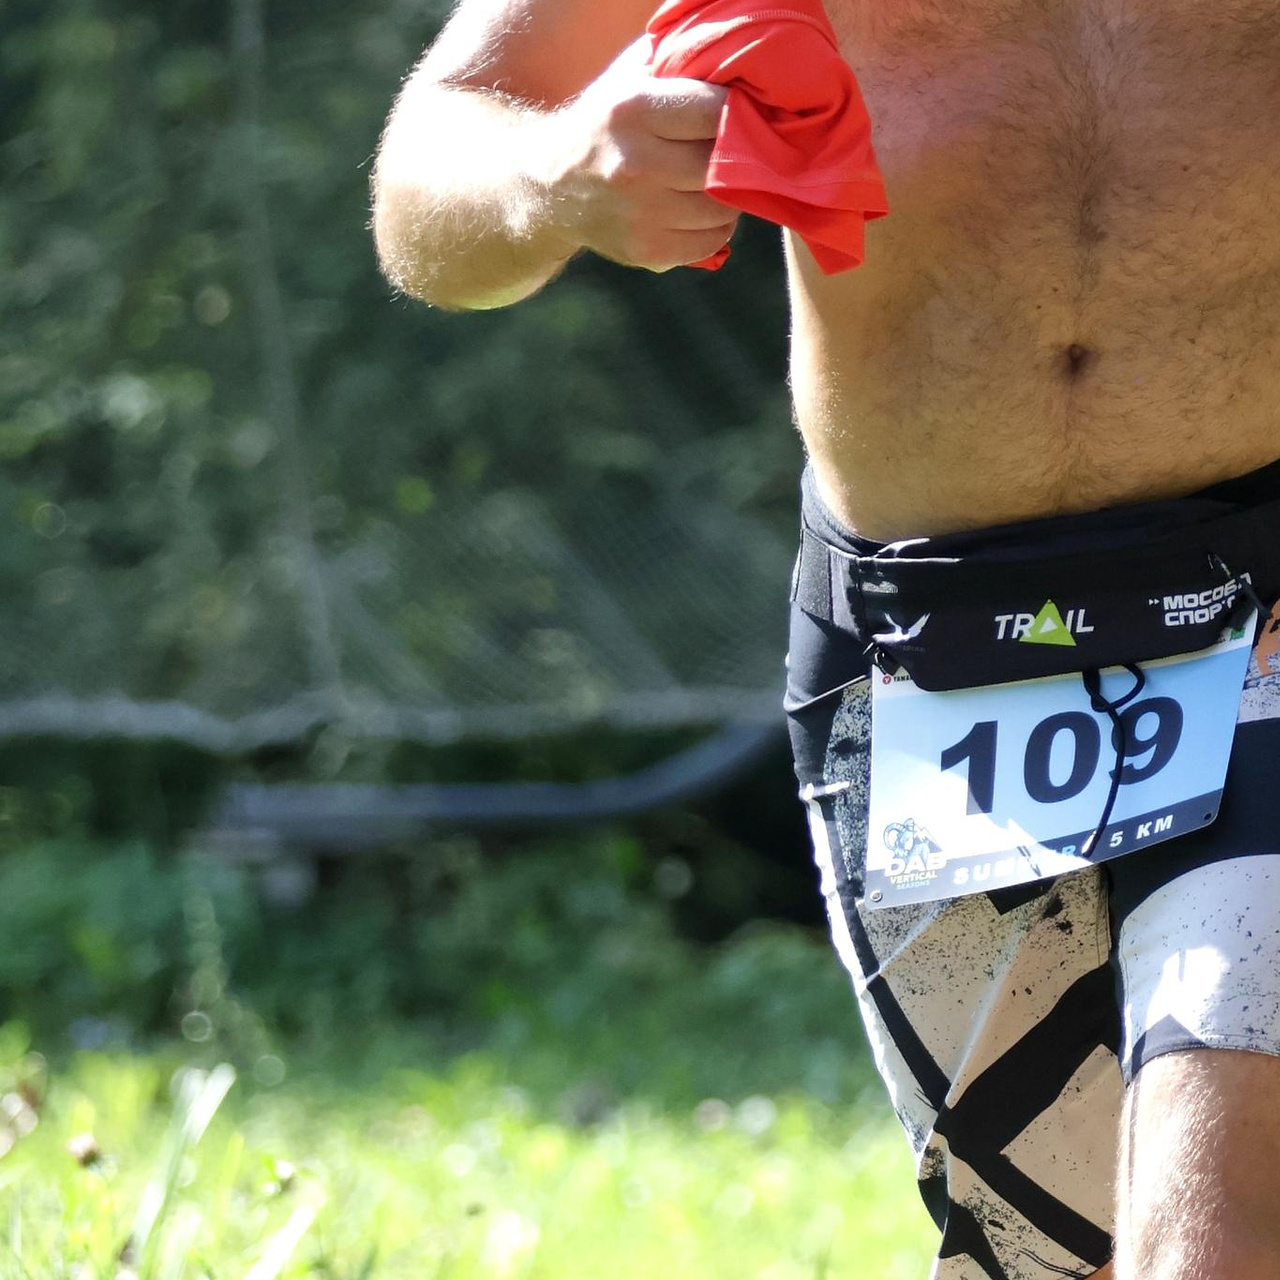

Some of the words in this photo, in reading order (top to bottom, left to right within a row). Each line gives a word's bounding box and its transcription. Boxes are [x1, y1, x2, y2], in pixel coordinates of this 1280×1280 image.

[994, 599, 1095, 647] TRAIL
[940, 696, 1184, 816] 109
[1109, 830, 1124, 848] 5
[1136, 814, 1174, 840] KM
[889, 870, 939, 886] VERTICAL
[895, 880, 931, 891] SEASONS
